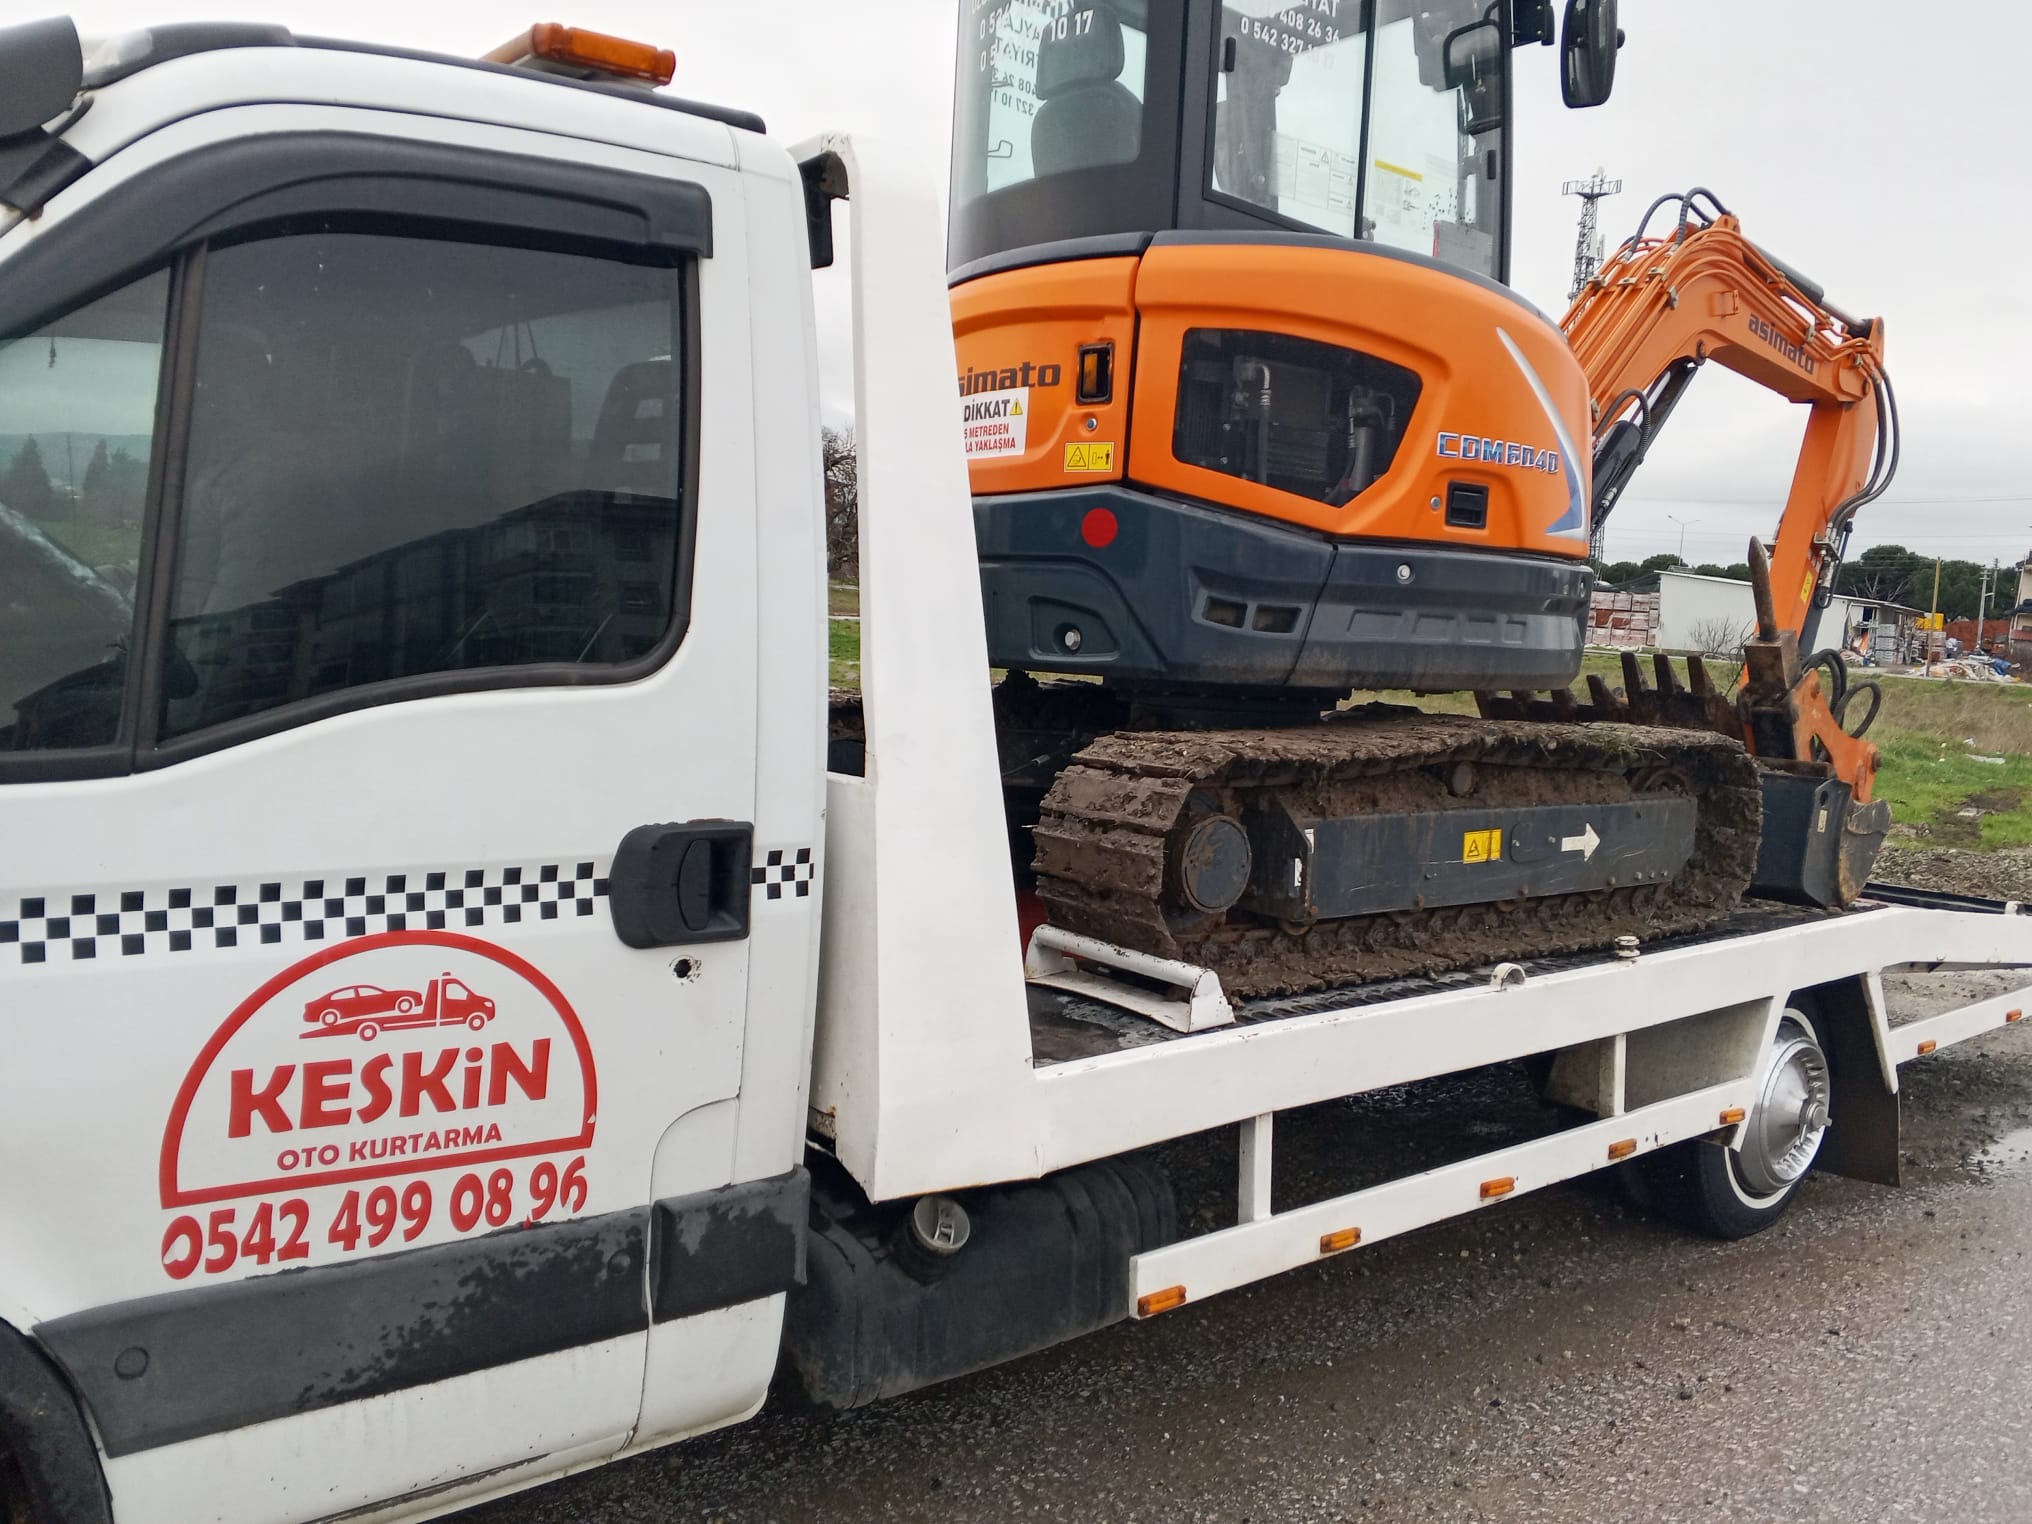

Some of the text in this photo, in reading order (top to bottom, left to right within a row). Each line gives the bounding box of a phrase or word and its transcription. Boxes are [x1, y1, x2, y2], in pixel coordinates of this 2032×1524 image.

[1050, 16, 1069, 41] 10
[1074, 9, 1095, 37] 17
[1240, 17, 1304, 55] 0 542 327
[1307, 18, 1321, 38] 26
[1325, 26, 1340, 44] 36
[1748, 312, 1815, 376] asimato
[963, 399, 1010, 423] DİKKAT
[969, 423, 1010, 438] METREDEN
[975, 437, 1016, 453] YAKLAŞMA
[276, 1122, 503, 1171] OTO KURTARMA
[160, 1156, 589, 1280] 0542 499 08 96
